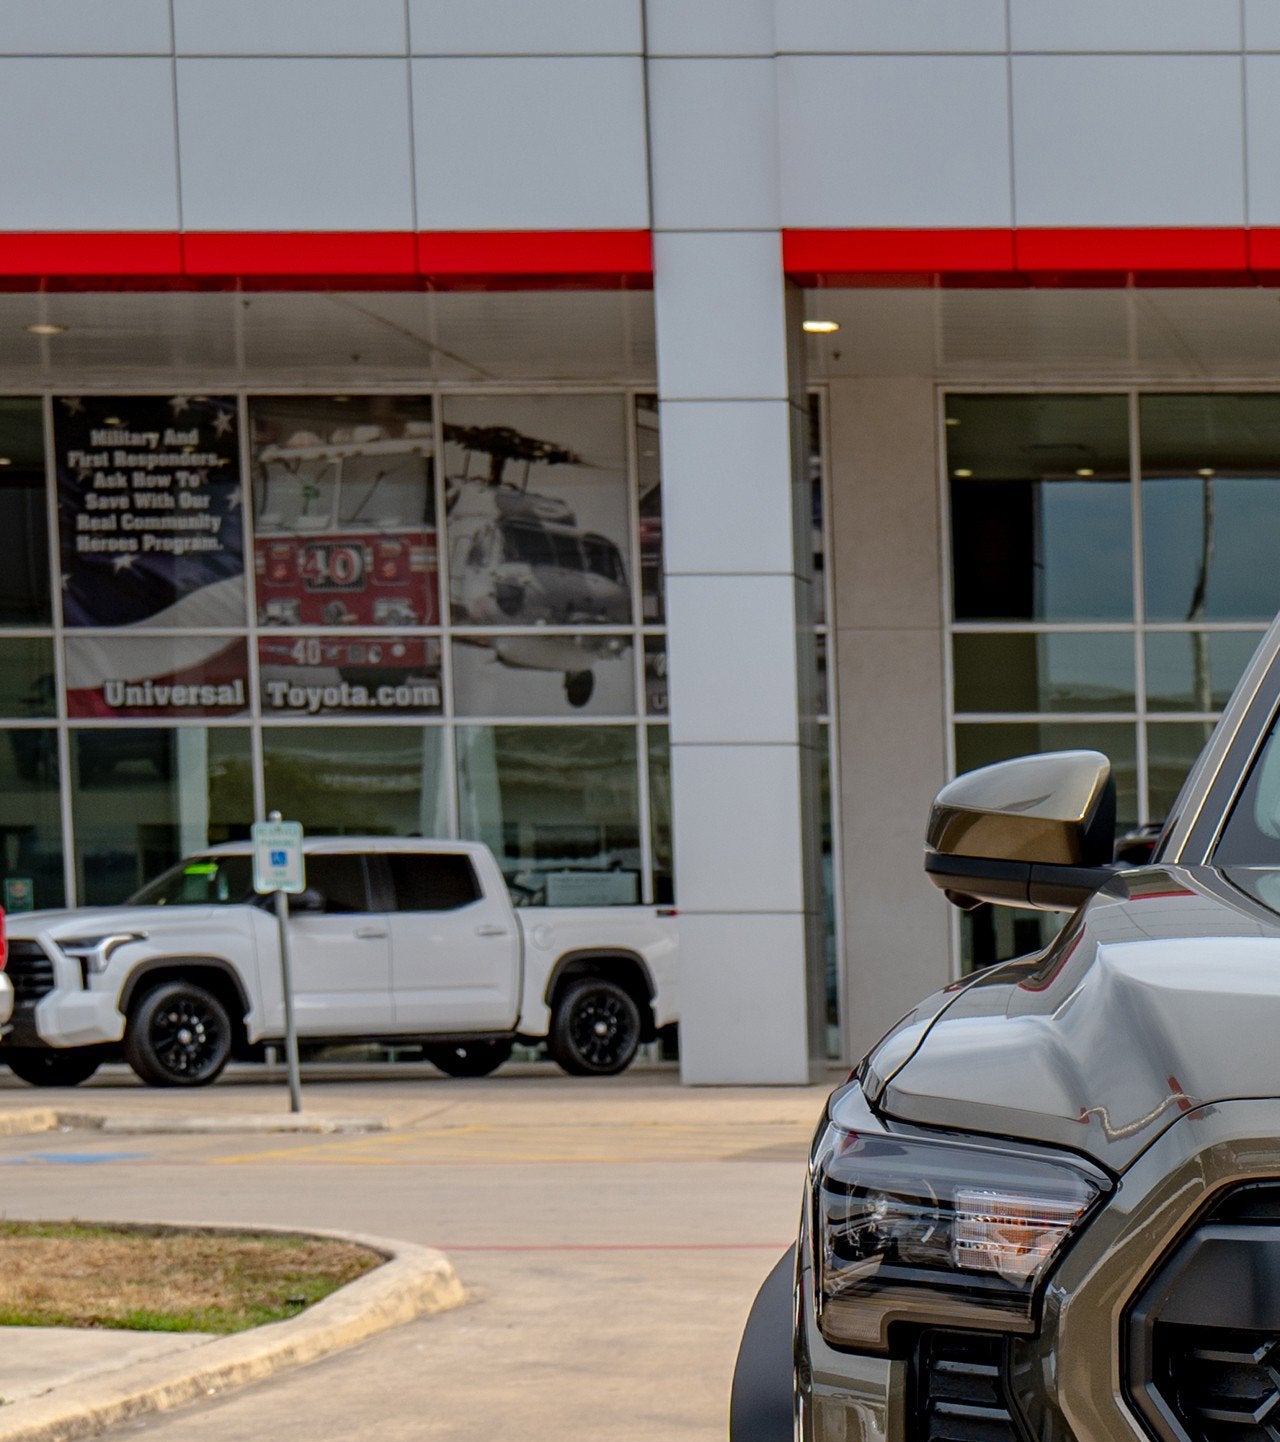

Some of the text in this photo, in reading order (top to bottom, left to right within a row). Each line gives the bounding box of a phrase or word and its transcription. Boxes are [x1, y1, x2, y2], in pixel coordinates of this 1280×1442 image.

[90, 427, 199, 449] Military And
[67, 450, 109, 468] First
[93, 470, 200, 489] Ask How To
[85, 491, 211, 510] Save With Our
[76, 511, 222, 533] Real Community
[76, 533, 224, 555] Heroes Program.
[104, 679, 441, 713] Universal Toyota.com
